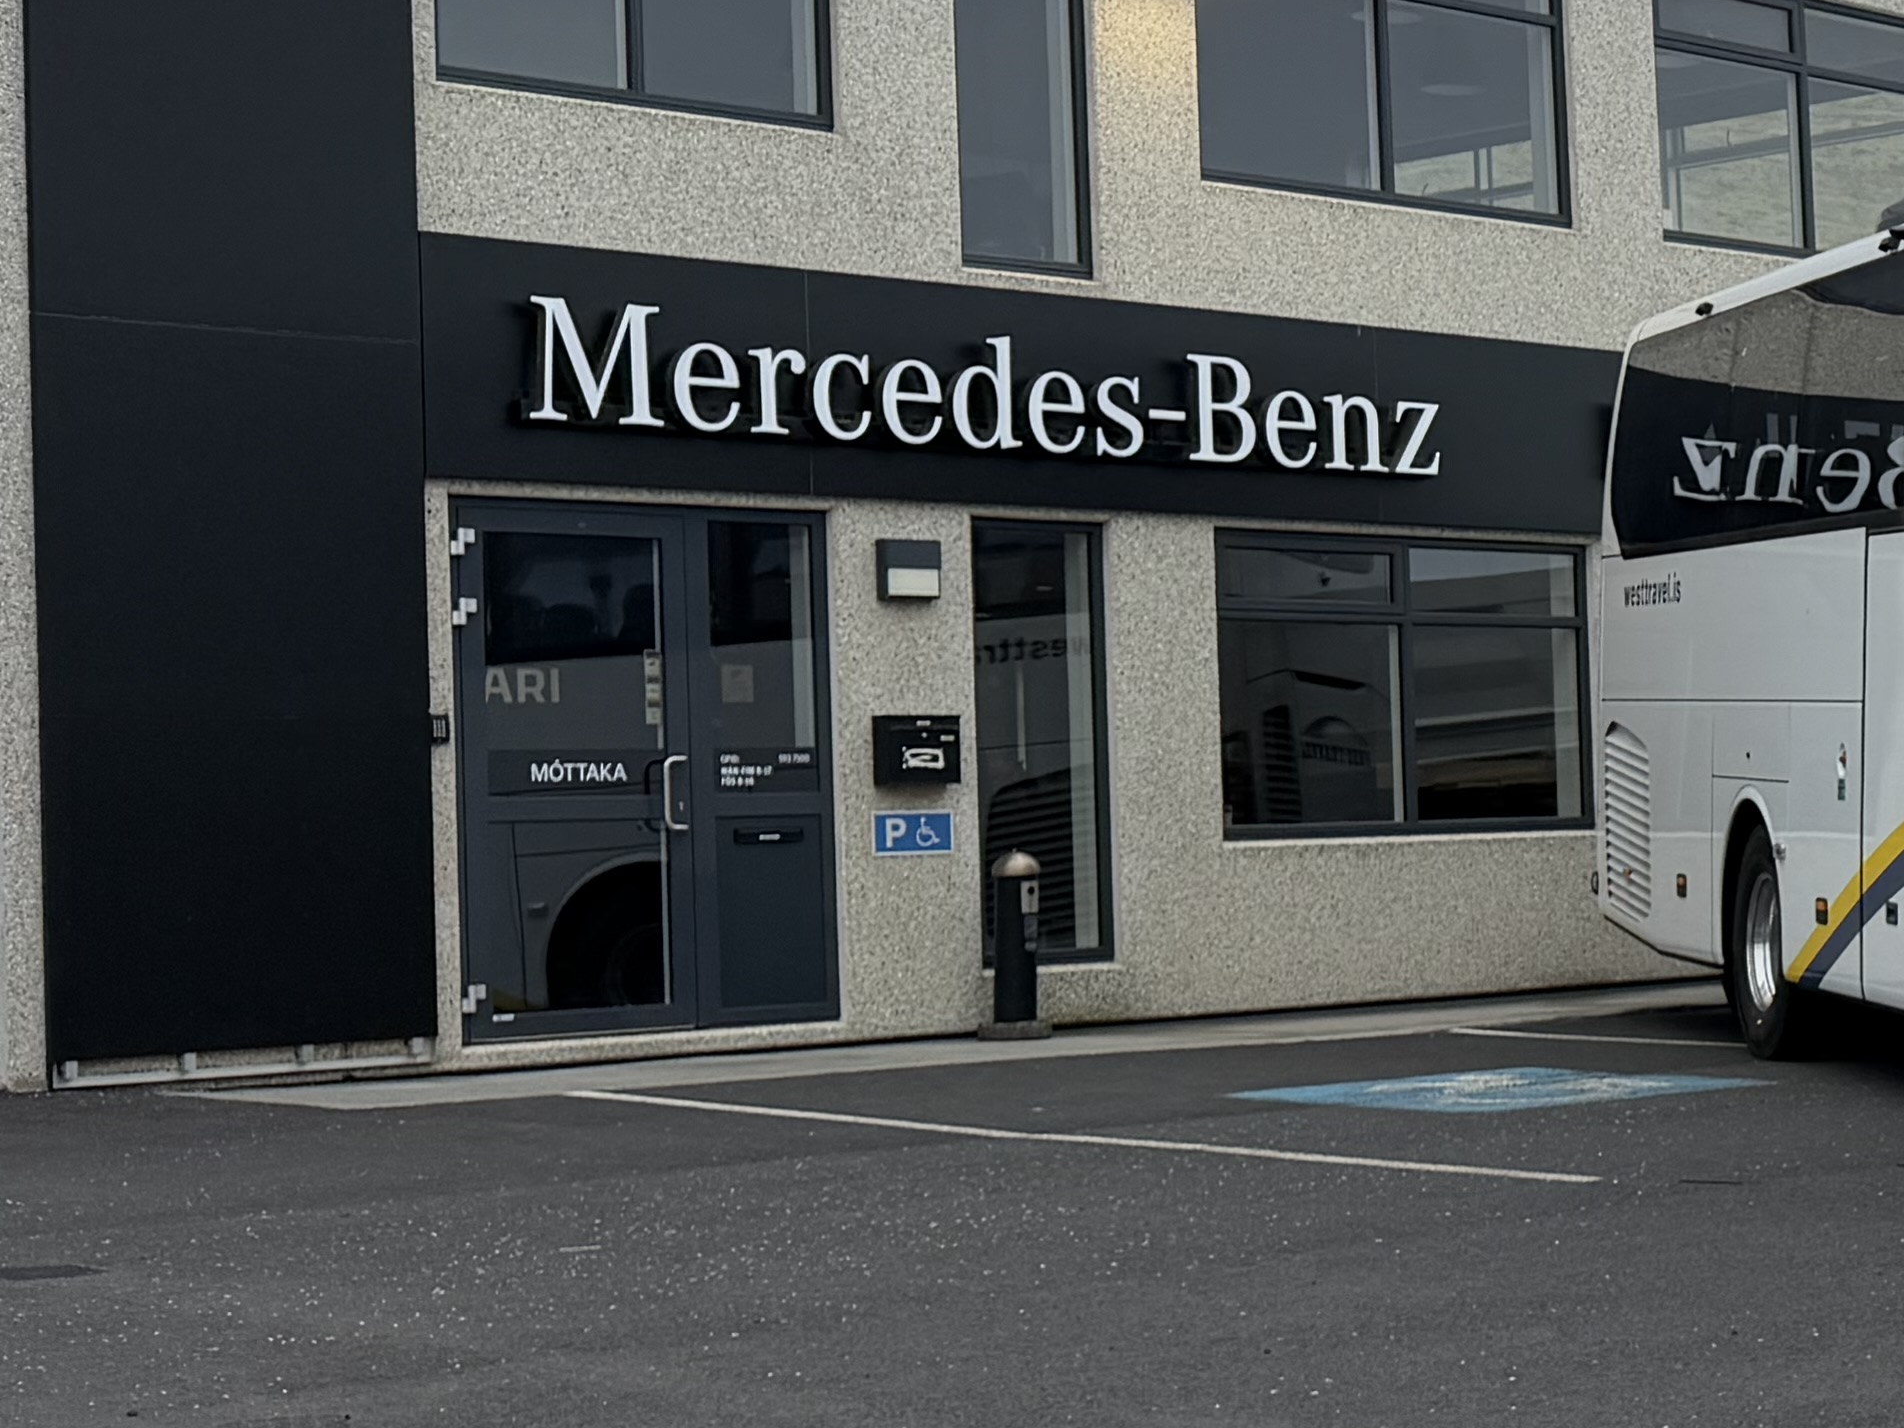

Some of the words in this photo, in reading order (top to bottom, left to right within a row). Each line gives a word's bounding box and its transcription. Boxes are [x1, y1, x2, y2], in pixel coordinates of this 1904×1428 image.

[529, 295, 1441, 476] Mercedes-Benz
[530, 759, 628, 783] MÓTTAKA
[885, 818, 907, 848] P
